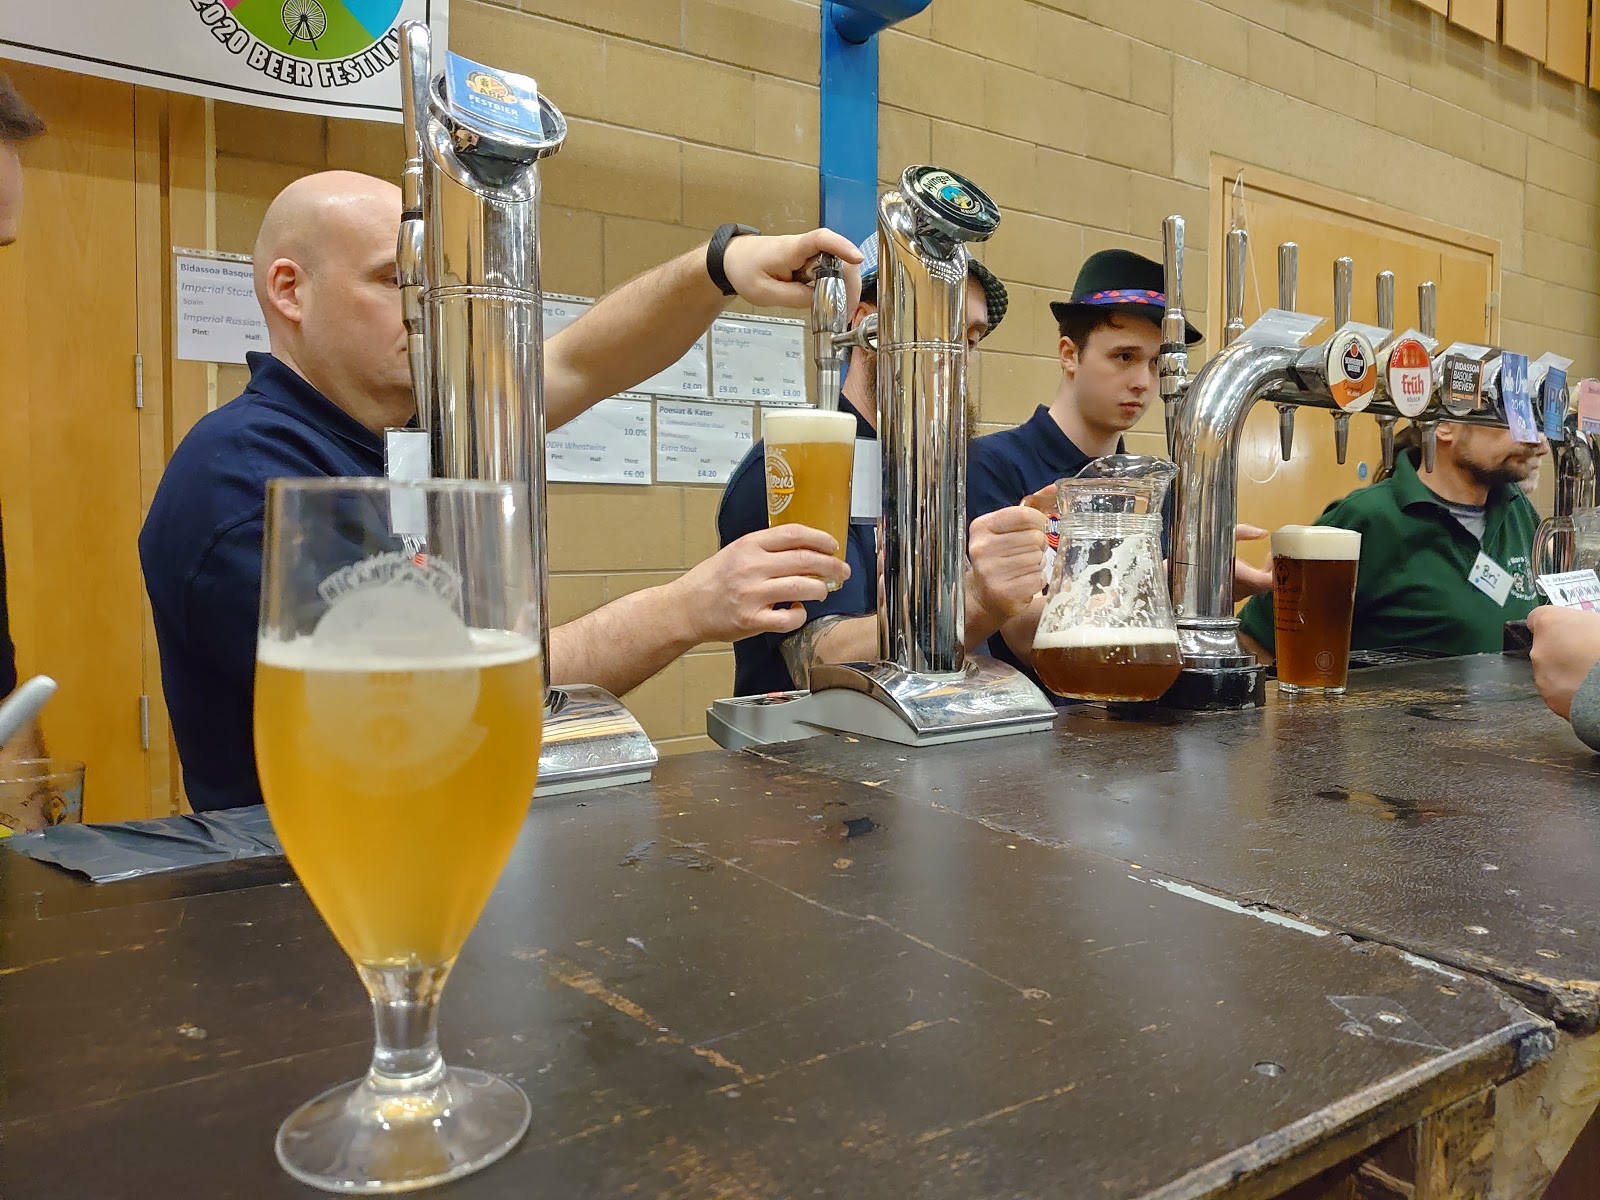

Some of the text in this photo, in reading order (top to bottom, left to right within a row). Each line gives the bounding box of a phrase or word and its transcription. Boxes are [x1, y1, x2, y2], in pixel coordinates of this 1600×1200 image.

[246, 42, 313, 87] BEER
[318, 27, 400, 87] FESTIVA
[469, 94, 519, 117] FESTBIER
[180, 263, 254, 279] Bidassoa Basque
[181, 282, 253, 298] Imperial Stout
[183, 298, 204, 306] Spain
[555, 308, 565, 316] Co
[184, 312, 224, 324] Imperial
[226, 316, 261, 327] Russian
[192, 328, 210, 336] Pint:
[1454, 362, 1479, 373] BIDASSOA
[1453, 371, 1473, 382] BASQUE
[1401, 374, 1425, 395] früh
[1452, 380, 1475, 392] BREWERY
[752, 388, 771, 396] £4.50
[783, 389, 800, 397] £3.00
[694, 409, 714, 417] Kater
[624, 428, 751, 439] 10.0% 7.1%
[661, 444, 679, 452] Extra
[680, 445, 698, 453] Stout
[697, 470, 717, 478] £4.20
